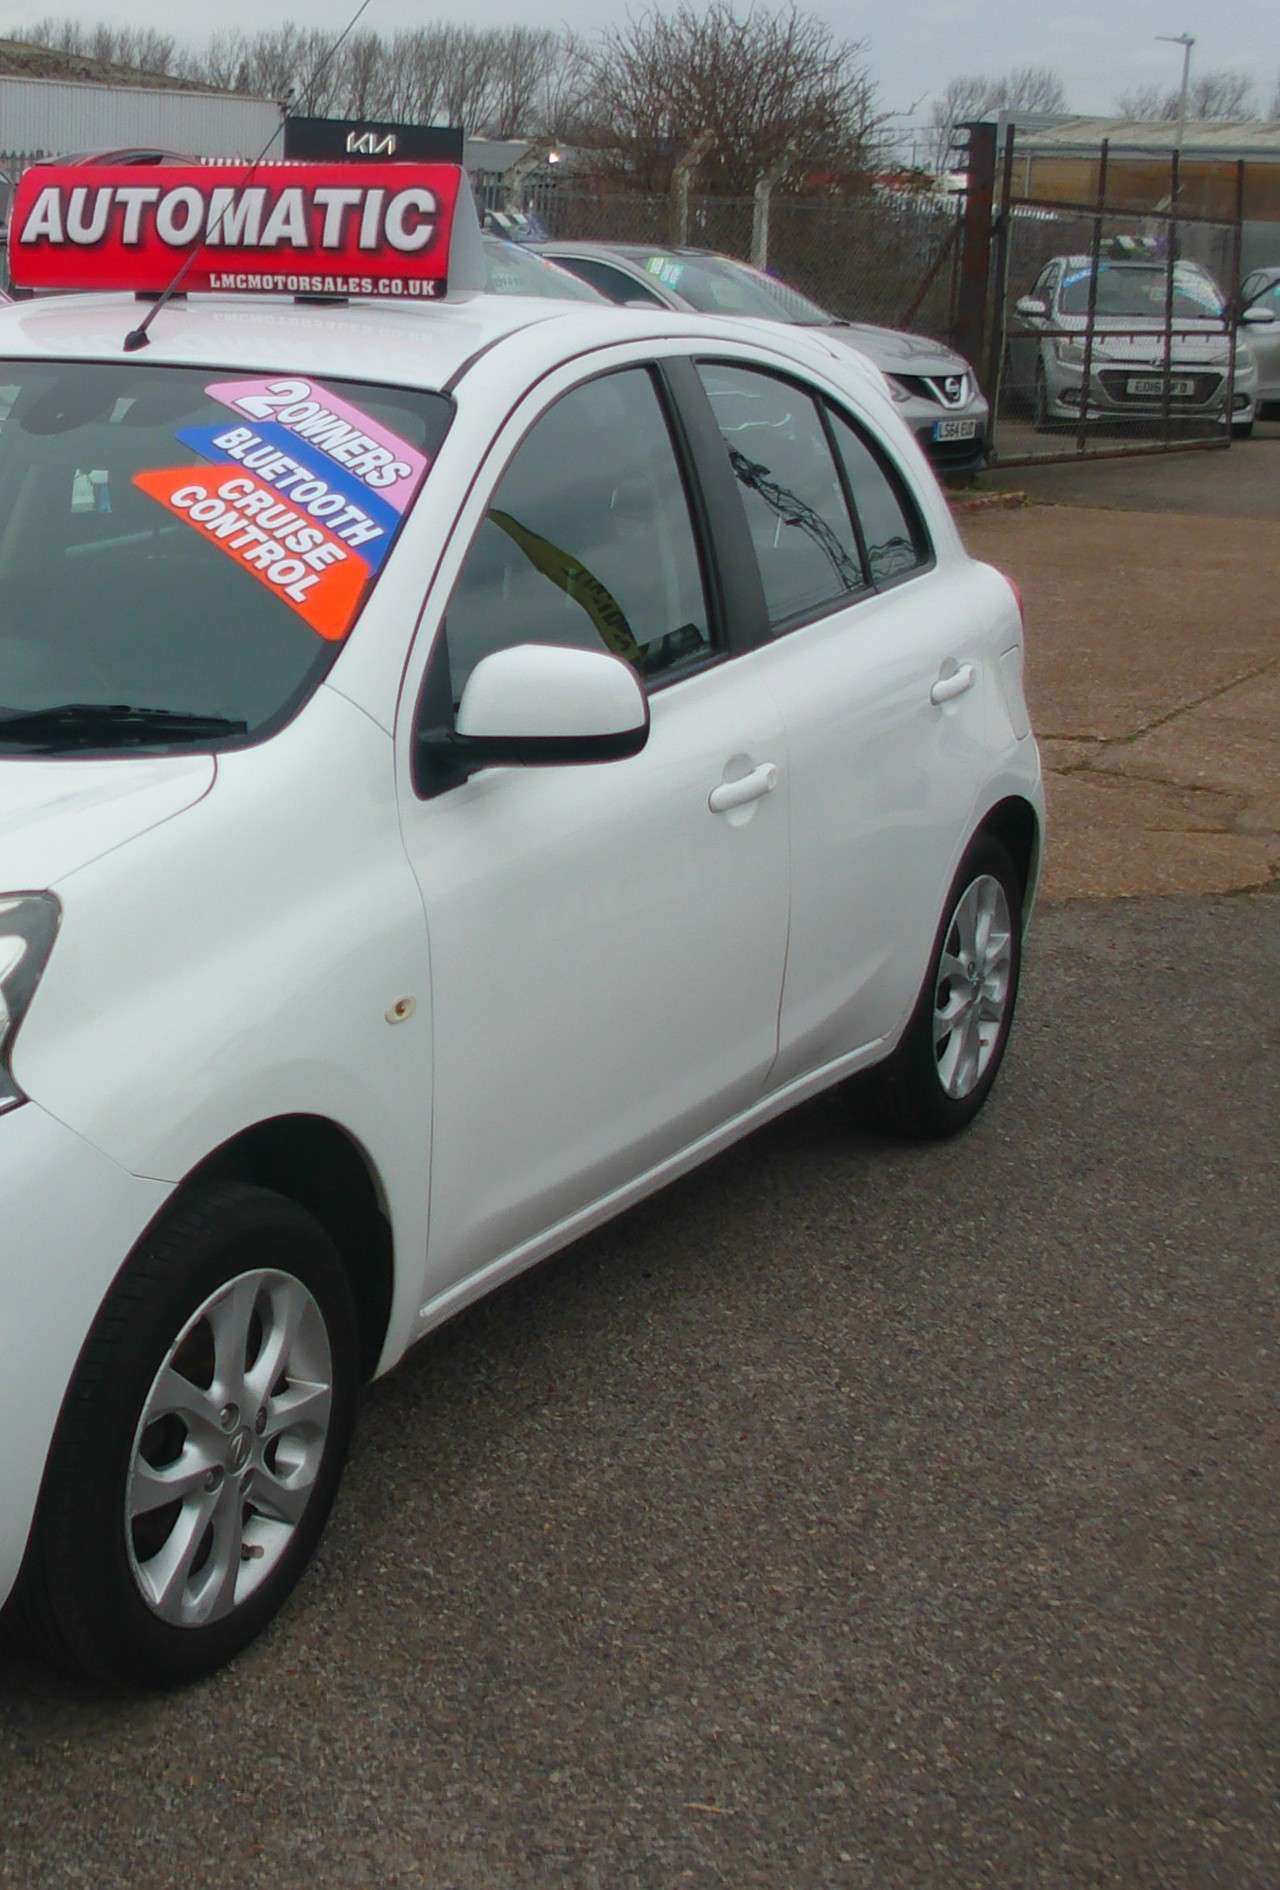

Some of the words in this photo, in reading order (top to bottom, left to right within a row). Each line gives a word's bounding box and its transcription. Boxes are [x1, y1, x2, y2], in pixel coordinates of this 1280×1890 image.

[19, 185, 437, 252] AUTOMATIC
[209, 272, 435, 296] LMCMOTORSALES.CO.UK
[230, 379, 312, 420] 2
[276, 400, 413, 488] OWNERS
[212, 426, 385, 548] BLUETOOTH
[218, 477, 348, 572] CRUISE
[170, 484, 321, 605] CONTROL
